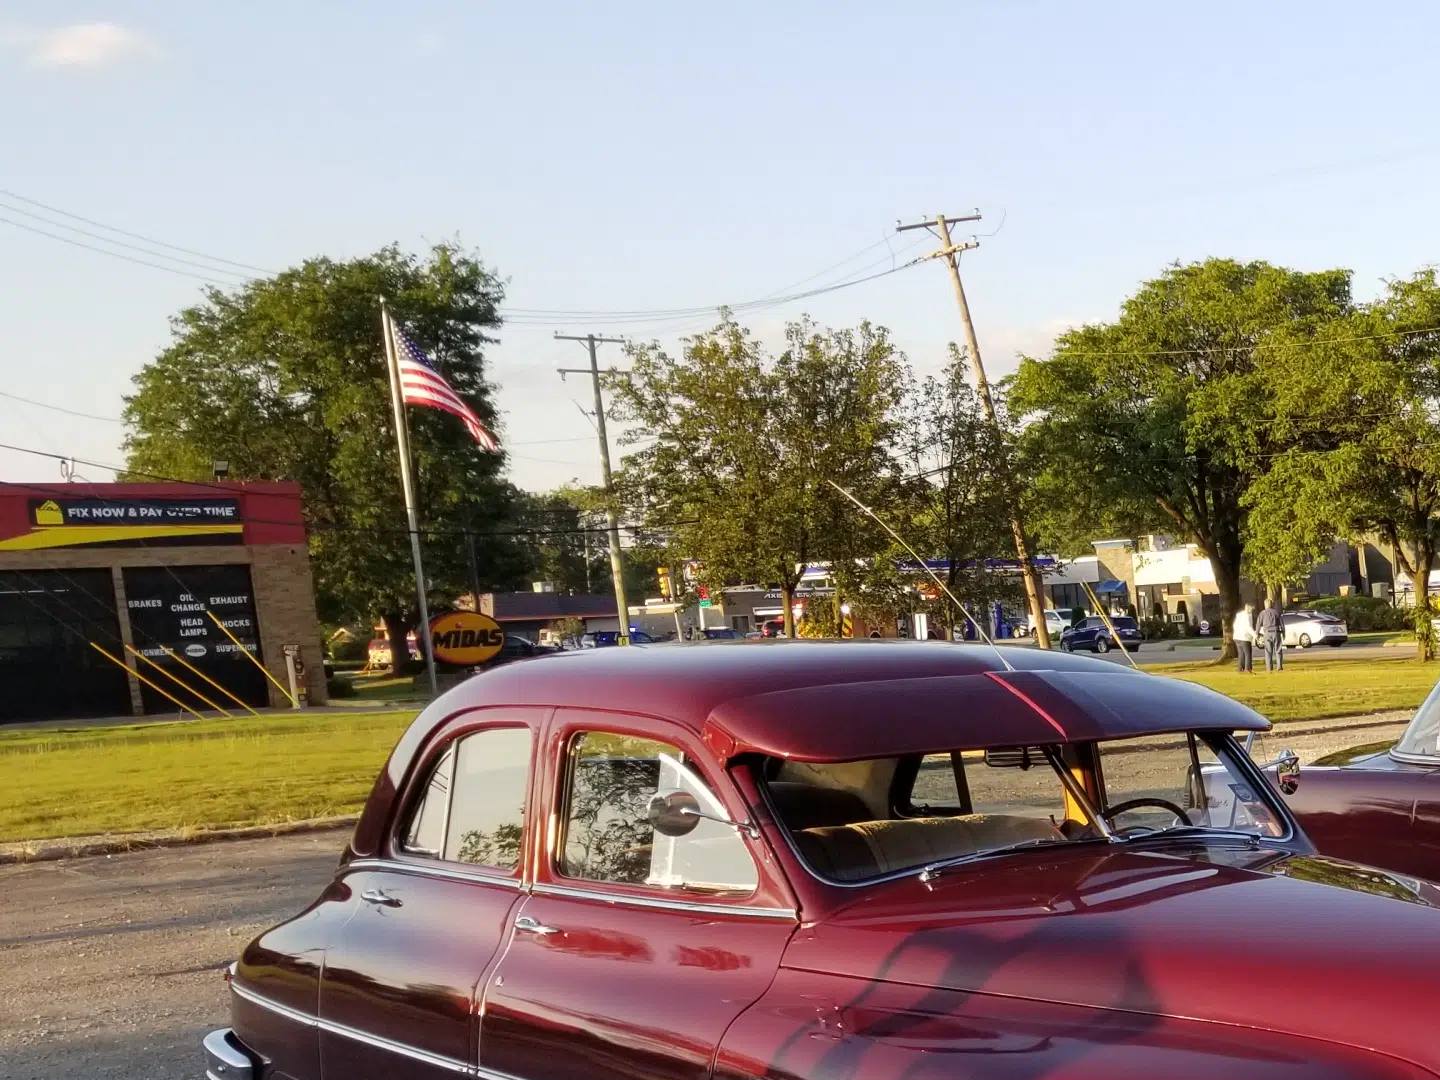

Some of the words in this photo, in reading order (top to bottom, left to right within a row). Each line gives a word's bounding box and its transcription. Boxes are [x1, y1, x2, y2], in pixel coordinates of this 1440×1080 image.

[68, 508, 89, 518] FIX
[92, 507, 124, 517] NOW
[128, 507, 137, 517] &
[140, 507, 162, 517] PAY
[180, 594, 194, 602] OIL
[210, 596, 248, 605] EXHAUST
[128, 600, 162, 608] BRAKES
[171, 603, 206, 612] CHANGE
[181, 618, 204, 627] HEAD
[180, 628, 208, 637] LAMPS
[432, 622, 504, 650] MIDAS
